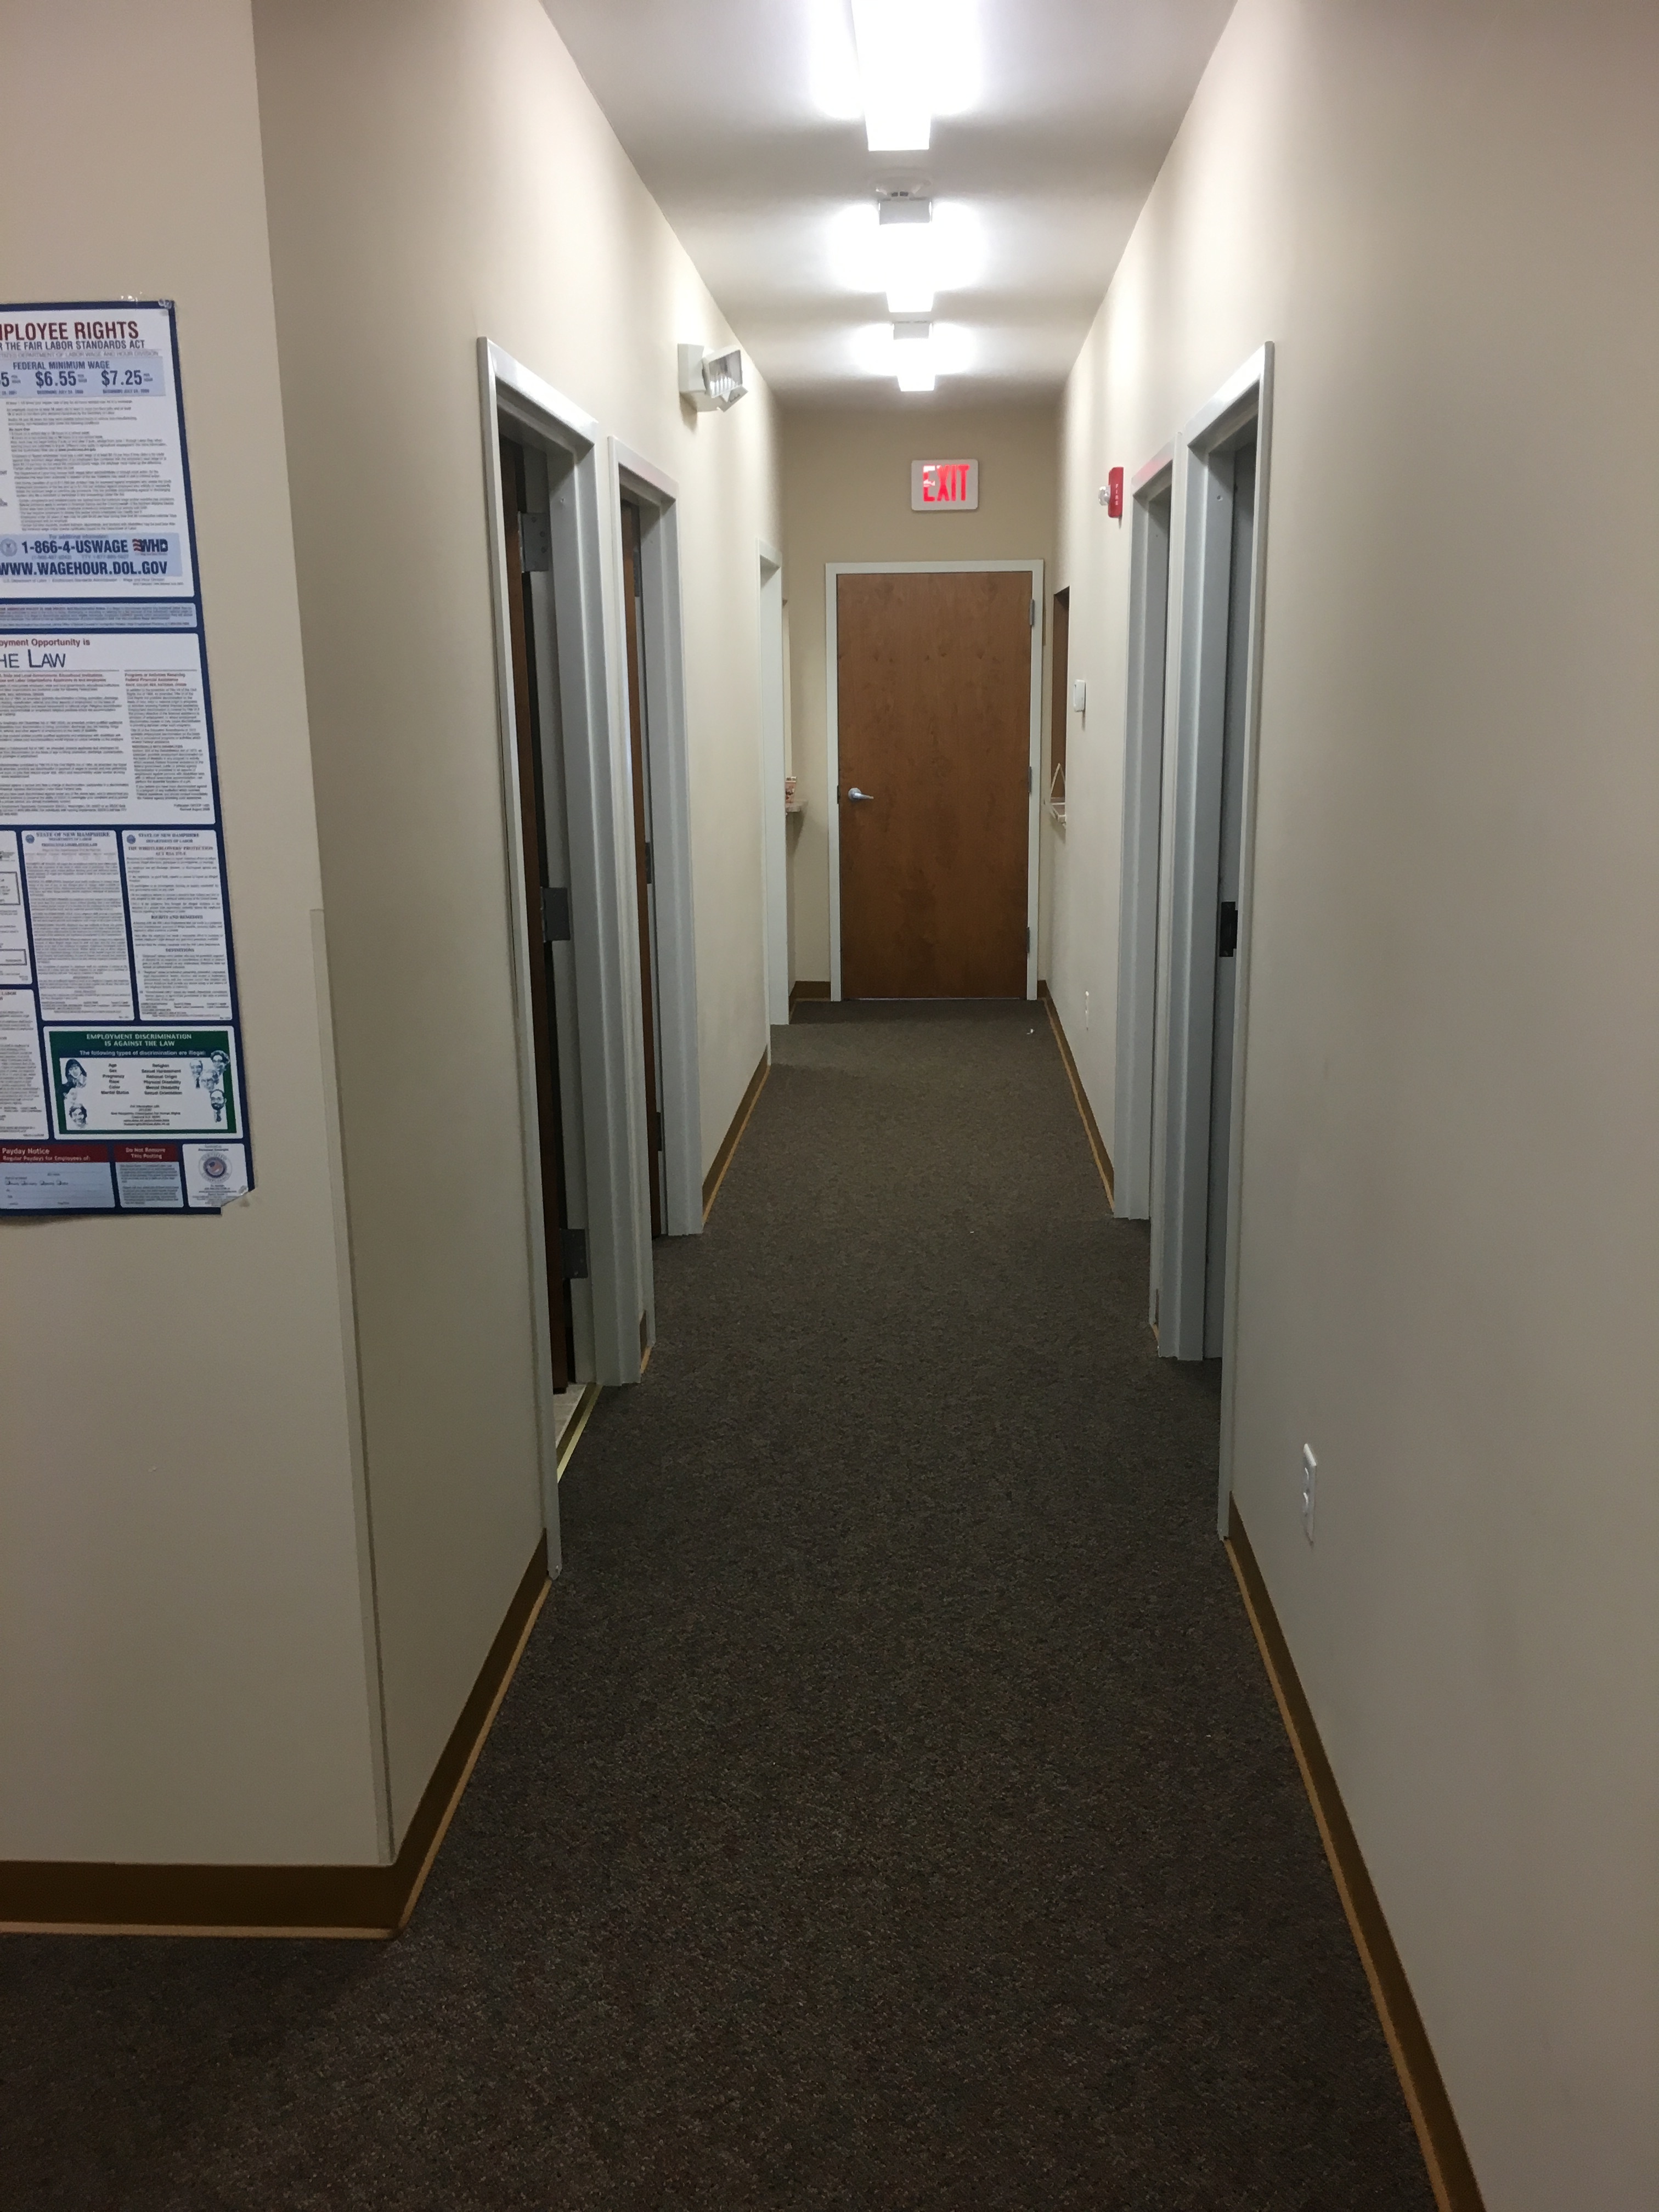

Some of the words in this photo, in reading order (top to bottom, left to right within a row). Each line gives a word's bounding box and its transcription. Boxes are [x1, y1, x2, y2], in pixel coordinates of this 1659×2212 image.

[0, 322, 69, 341] PLOYEE
[74, 321, 139, 340] RIGHTS
[5, 342, 21, 351] THE
[24, 341, 42, 350] FAIR
[46, 341, 73, 350] LABOR
[76, 340, 126, 349] STANDARDS
[129, 340, 145, 348] ACT
[48, 361, 85, 369] MINIMUM
[88, 360, 110, 369] WAGE
[35, 370, 76, 388] $6.55
[101, 369, 142, 387] $7.25
[923, 465, 970, 501] EXIT
[21, 539, 129, 554] 1-866-4-USWAGE
[139, 539, 168, 552] WHD
[0, 561, 167, 575] WWW.WAGEHOUR.DOL.GOV
[31, 638, 80, 647] Opportunity
